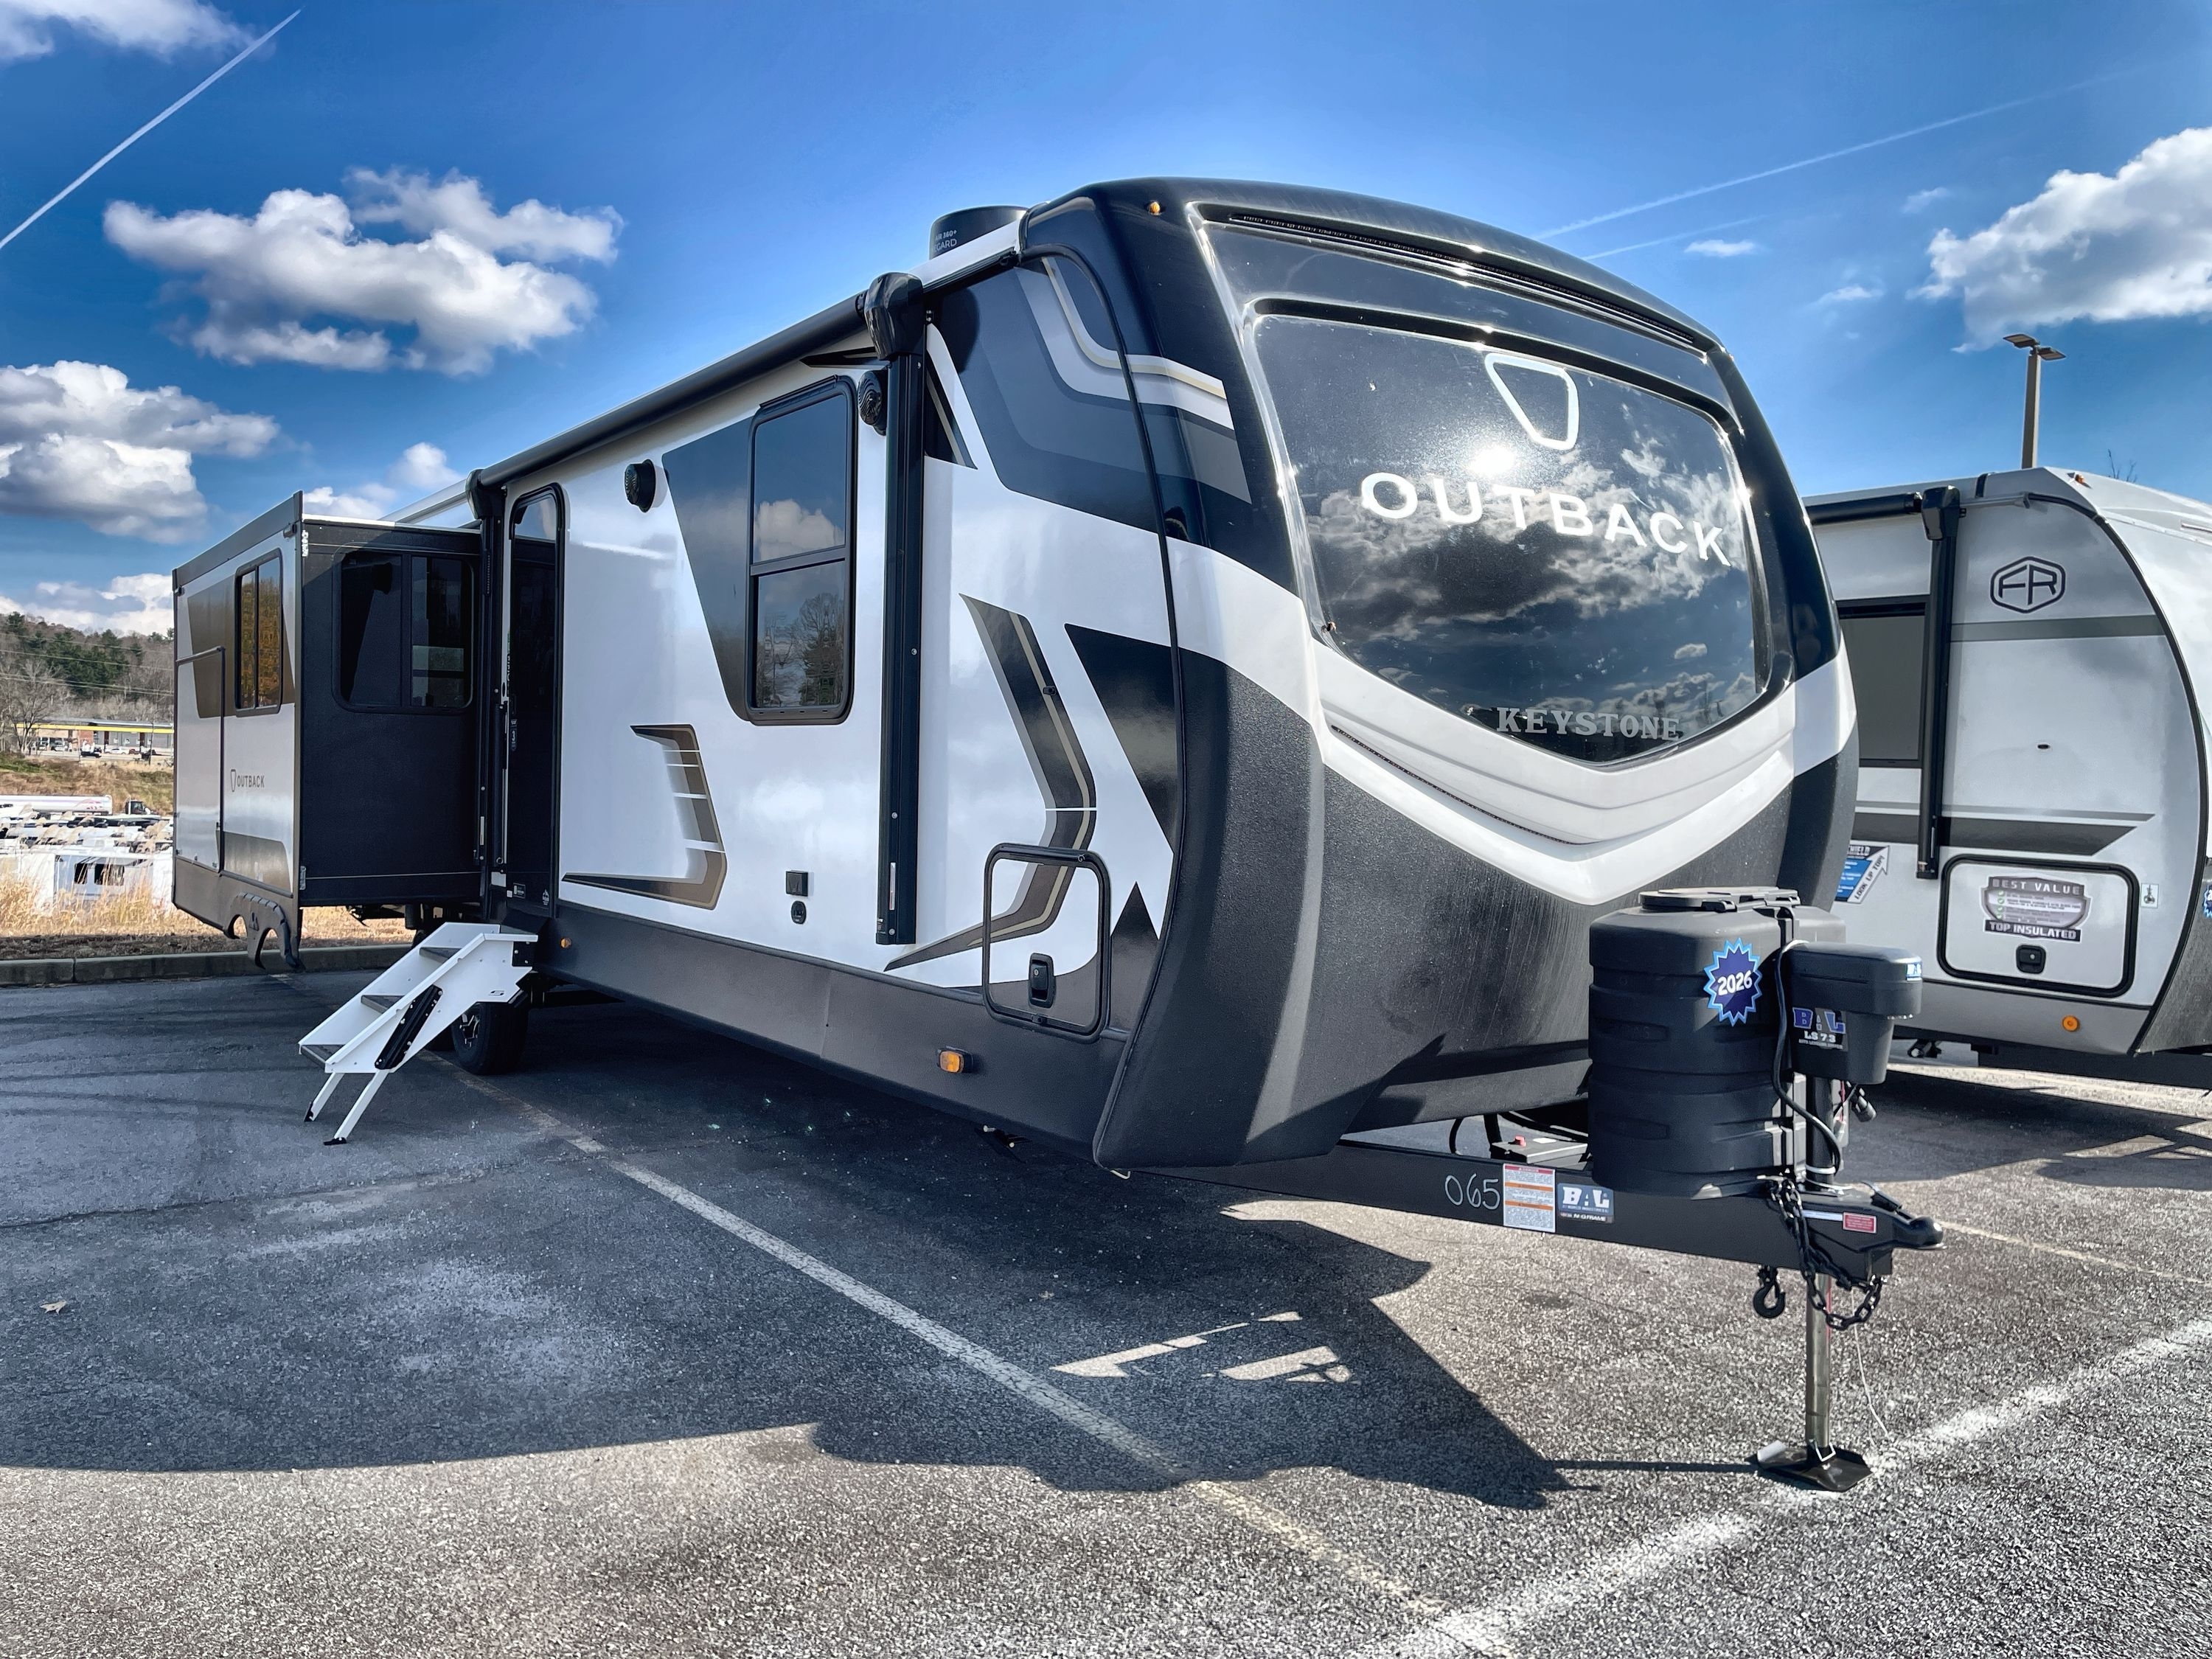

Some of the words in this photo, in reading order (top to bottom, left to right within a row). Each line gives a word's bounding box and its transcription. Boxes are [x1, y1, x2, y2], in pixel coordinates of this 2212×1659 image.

[1361, 472, 1731, 567] OUTBACK
[1998, 563, 2057, 605] FR
[1496, 706, 1680, 741] KEYSTONE
[237, 775, 265, 788] OUTBACK
[1854, 881, 1868, 900] LOOK
[1865, 871, 1874, 882] UP
[1992, 878, 2027, 890] BEST
[2034, 882, 2081, 895] VALUE
[1989, 921, 2011, 932] TOP
[2013, 924, 2077, 940] INSULATED
[1717, 970, 1753, 995] 2026
[1804, 1030, 1819, 1040] LS
[1445, 1173, 1500, 1210] 065
[1562, 1186, 1610, 1208] BAL
